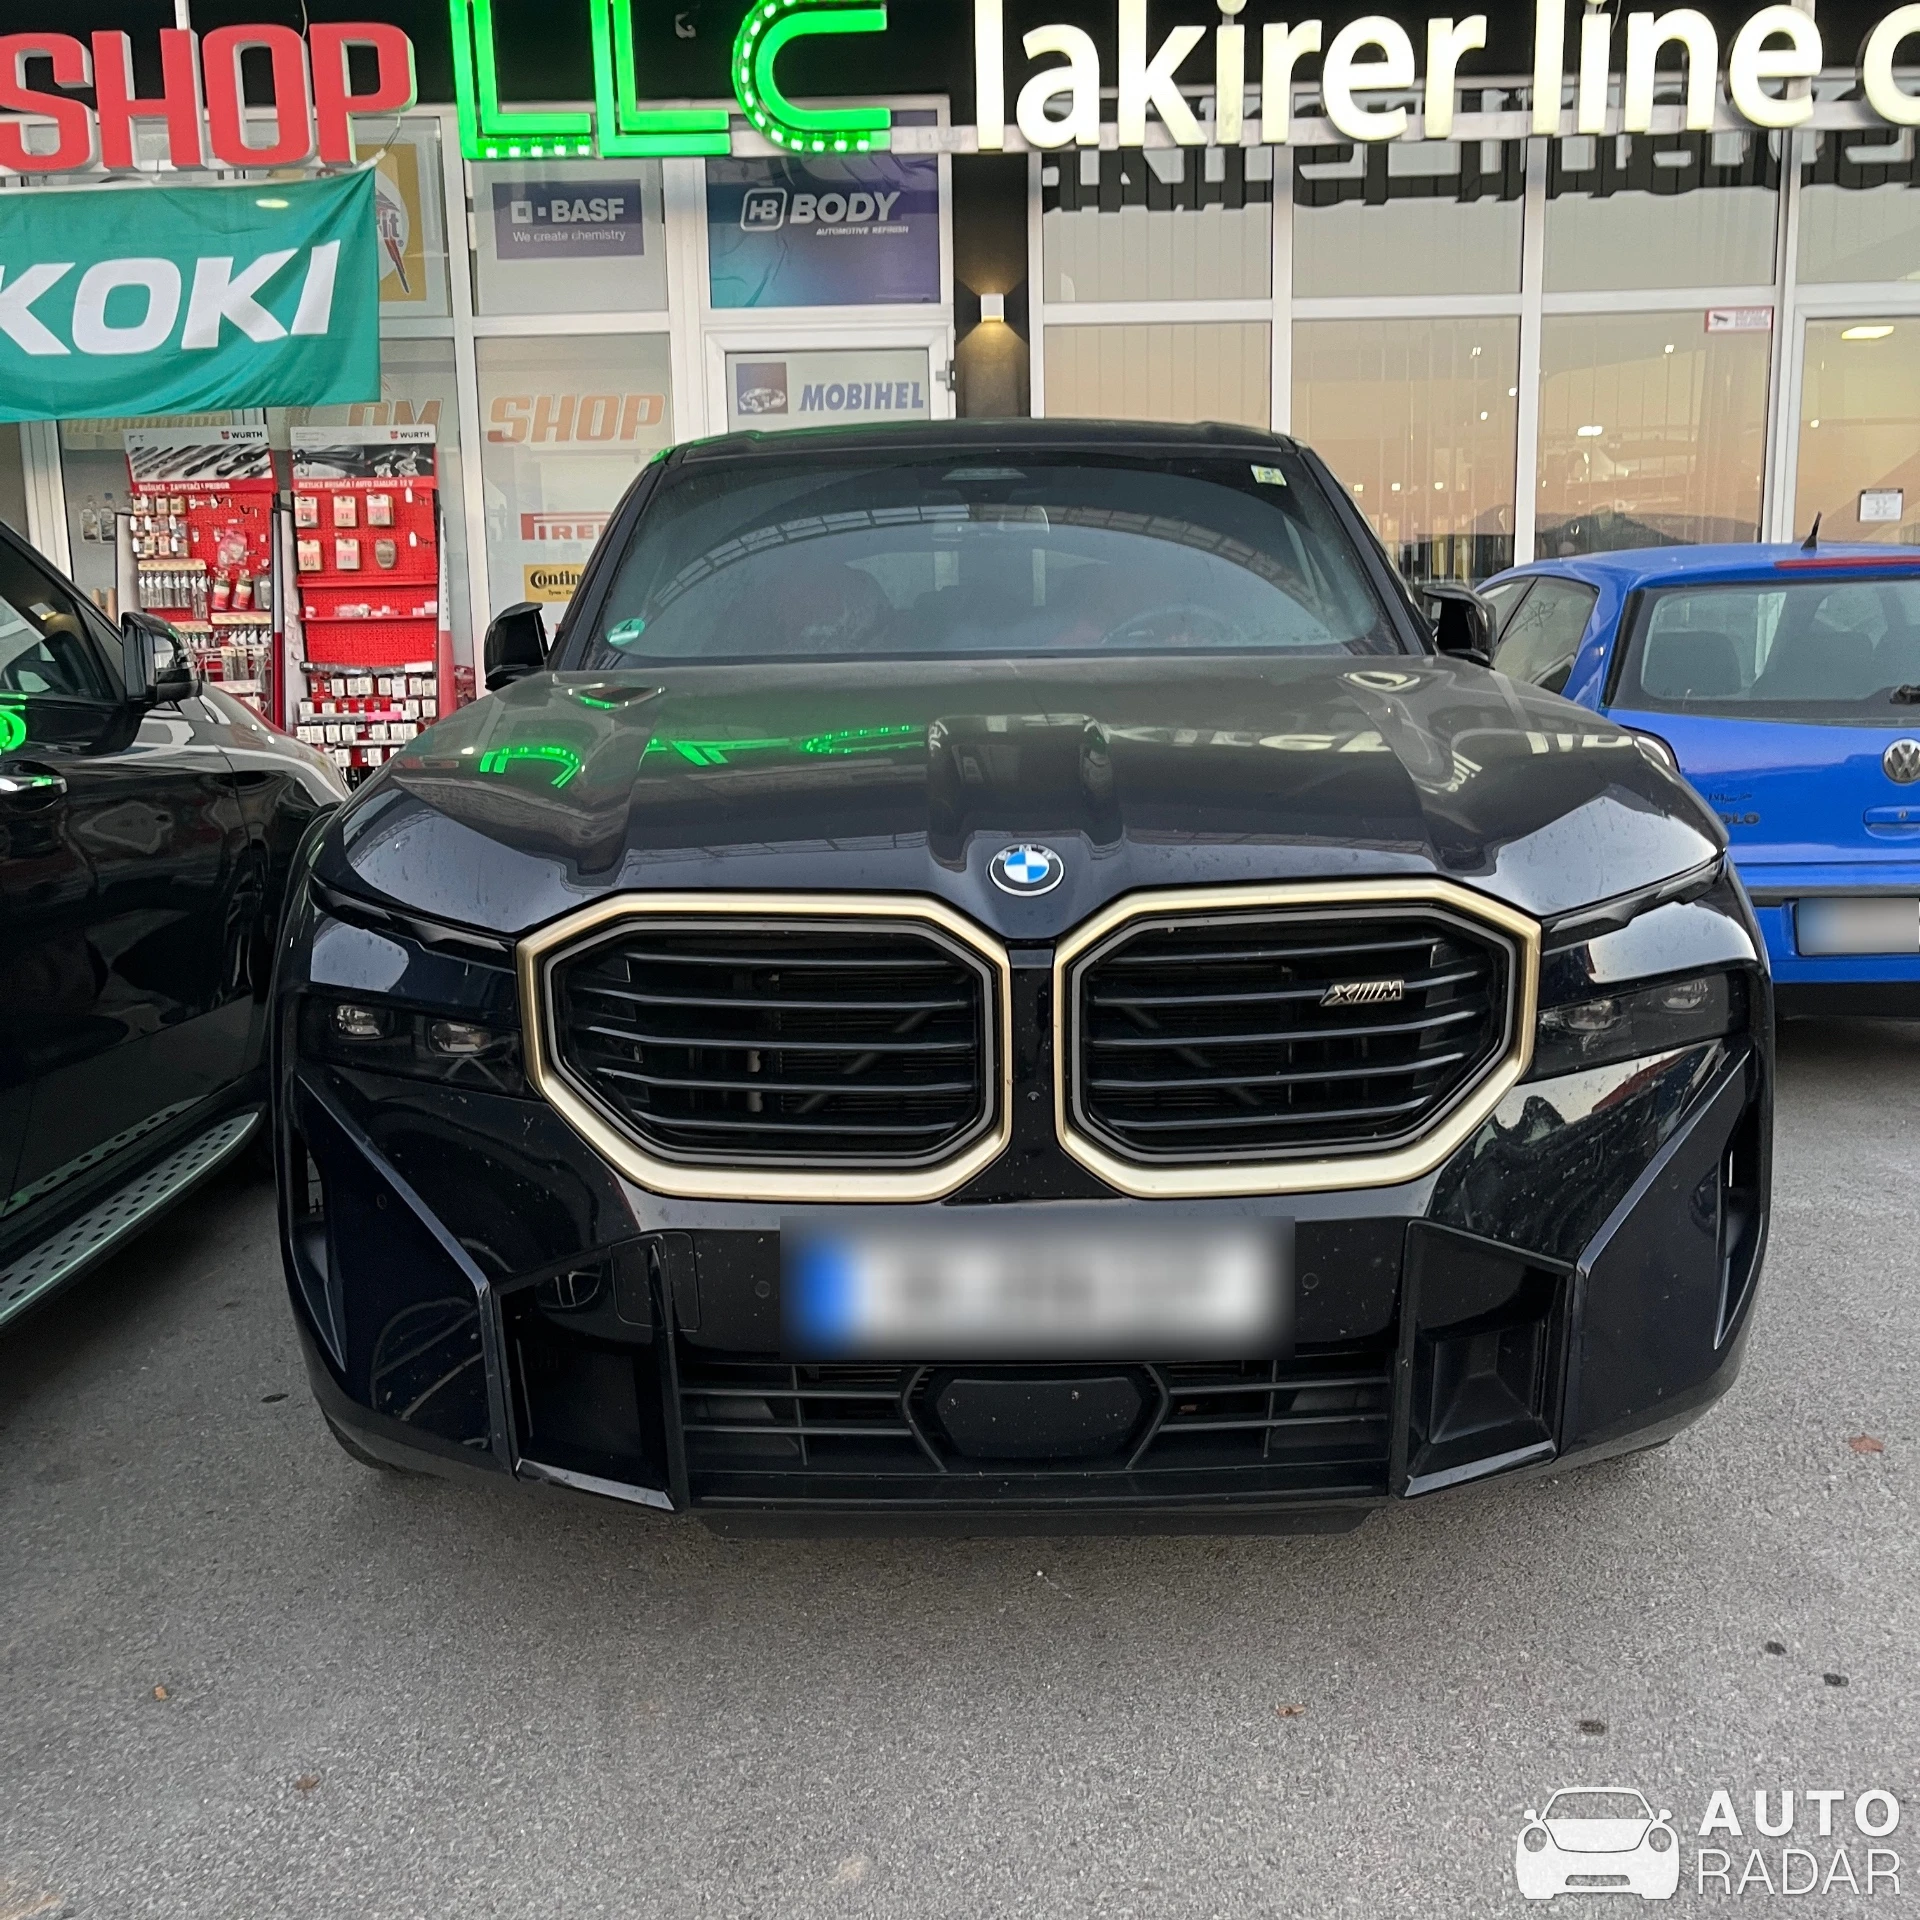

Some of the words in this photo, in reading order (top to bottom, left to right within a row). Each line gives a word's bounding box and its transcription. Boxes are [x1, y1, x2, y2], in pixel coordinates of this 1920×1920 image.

[450, 0, 892, 159] LLC
[974, 0, 1488, 150] lakirer
[1532, 0, 1823, 136] line
[0, 22, 417, 172] SHOP
[551, 198, 624, 223] BASF
[789, 191, 901, 224] BODY
[513, 231, 531, 242] We
[534, 231, 568, 242] create
[571, 229, 626, 241] chemistry
[816, 227, 869, 235] AUTOMOTIVE
[0, 239, 341, 355] KOKI
[798, 382, 924, 411] MOBIHEL
[487, 394, 666, 443] SHOP
[530, 570, 582, 589] Contin
